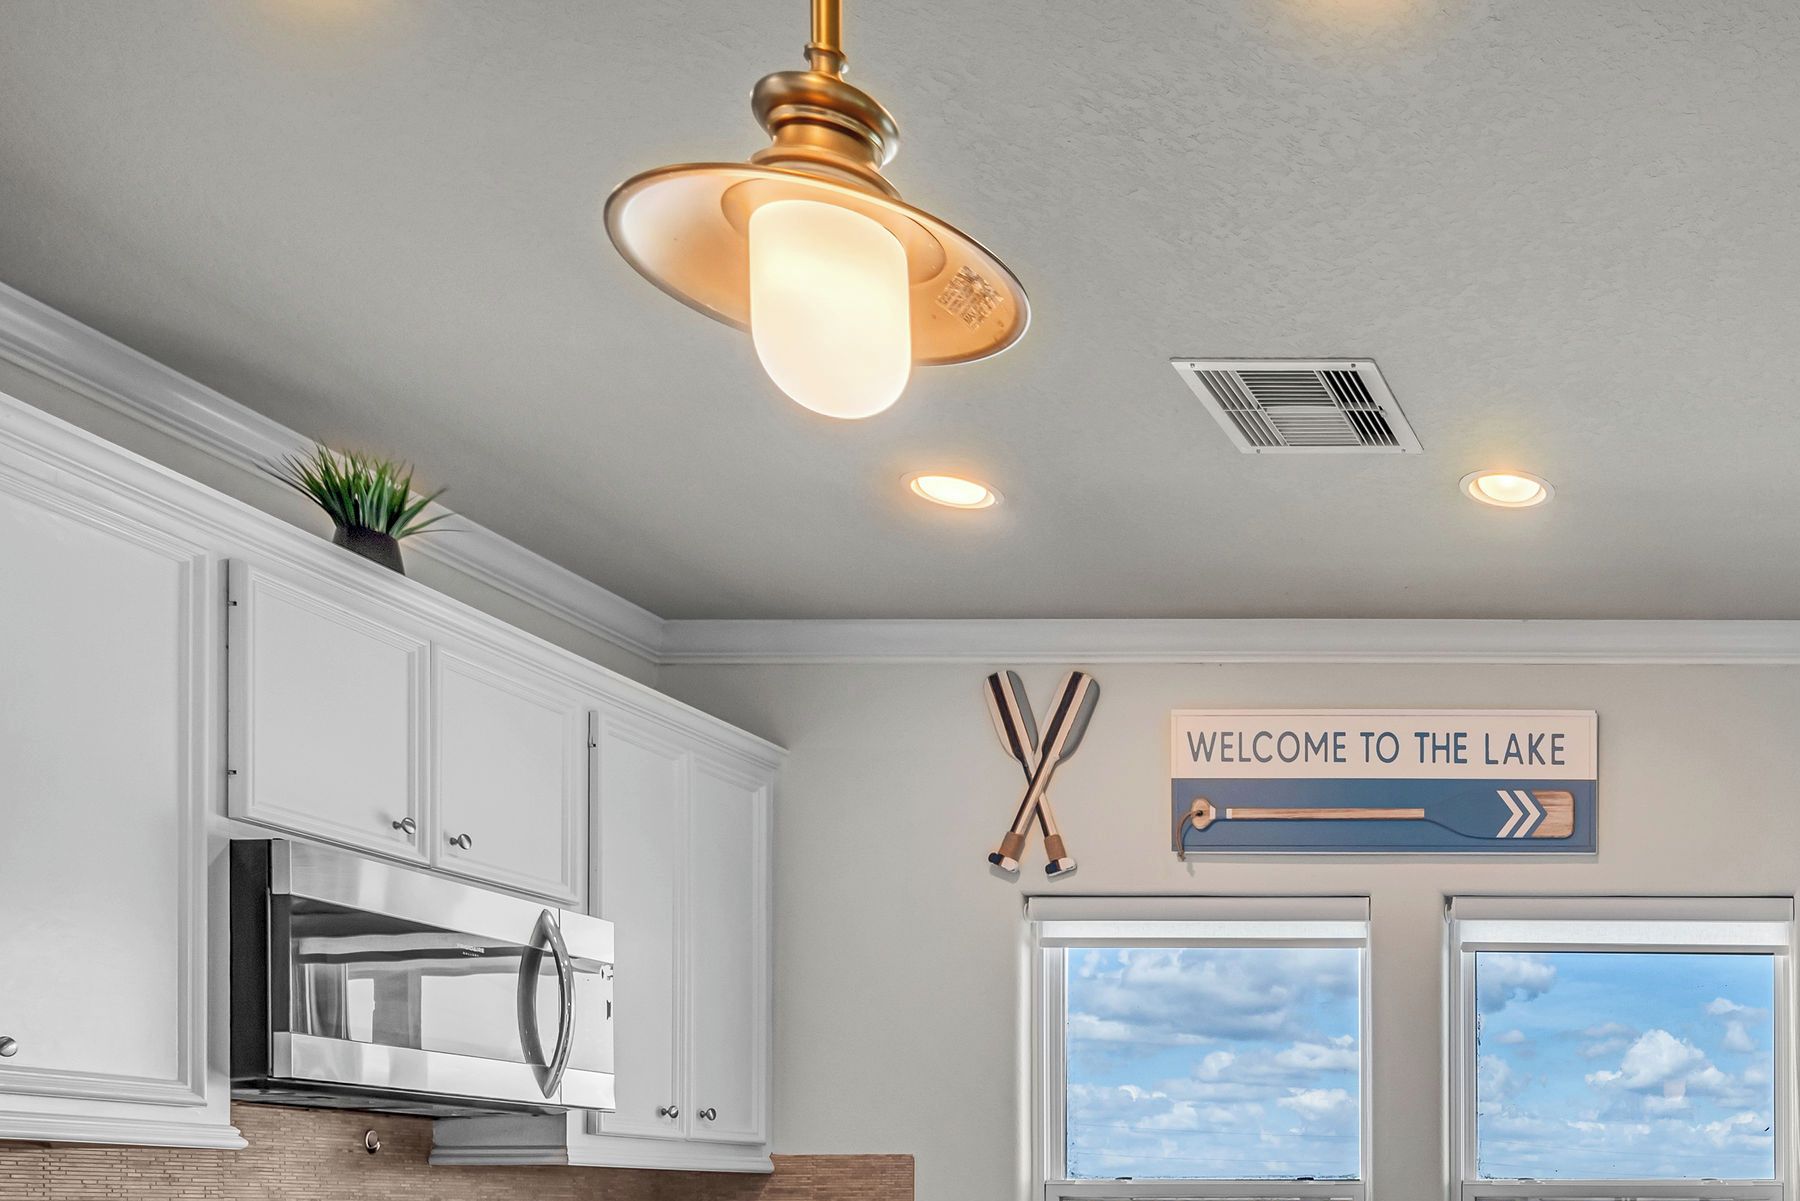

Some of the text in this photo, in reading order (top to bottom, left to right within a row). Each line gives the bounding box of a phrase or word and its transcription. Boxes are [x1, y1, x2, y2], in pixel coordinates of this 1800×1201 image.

[1187, 730, 1566, 766] WELCOME TO THE LAKE
